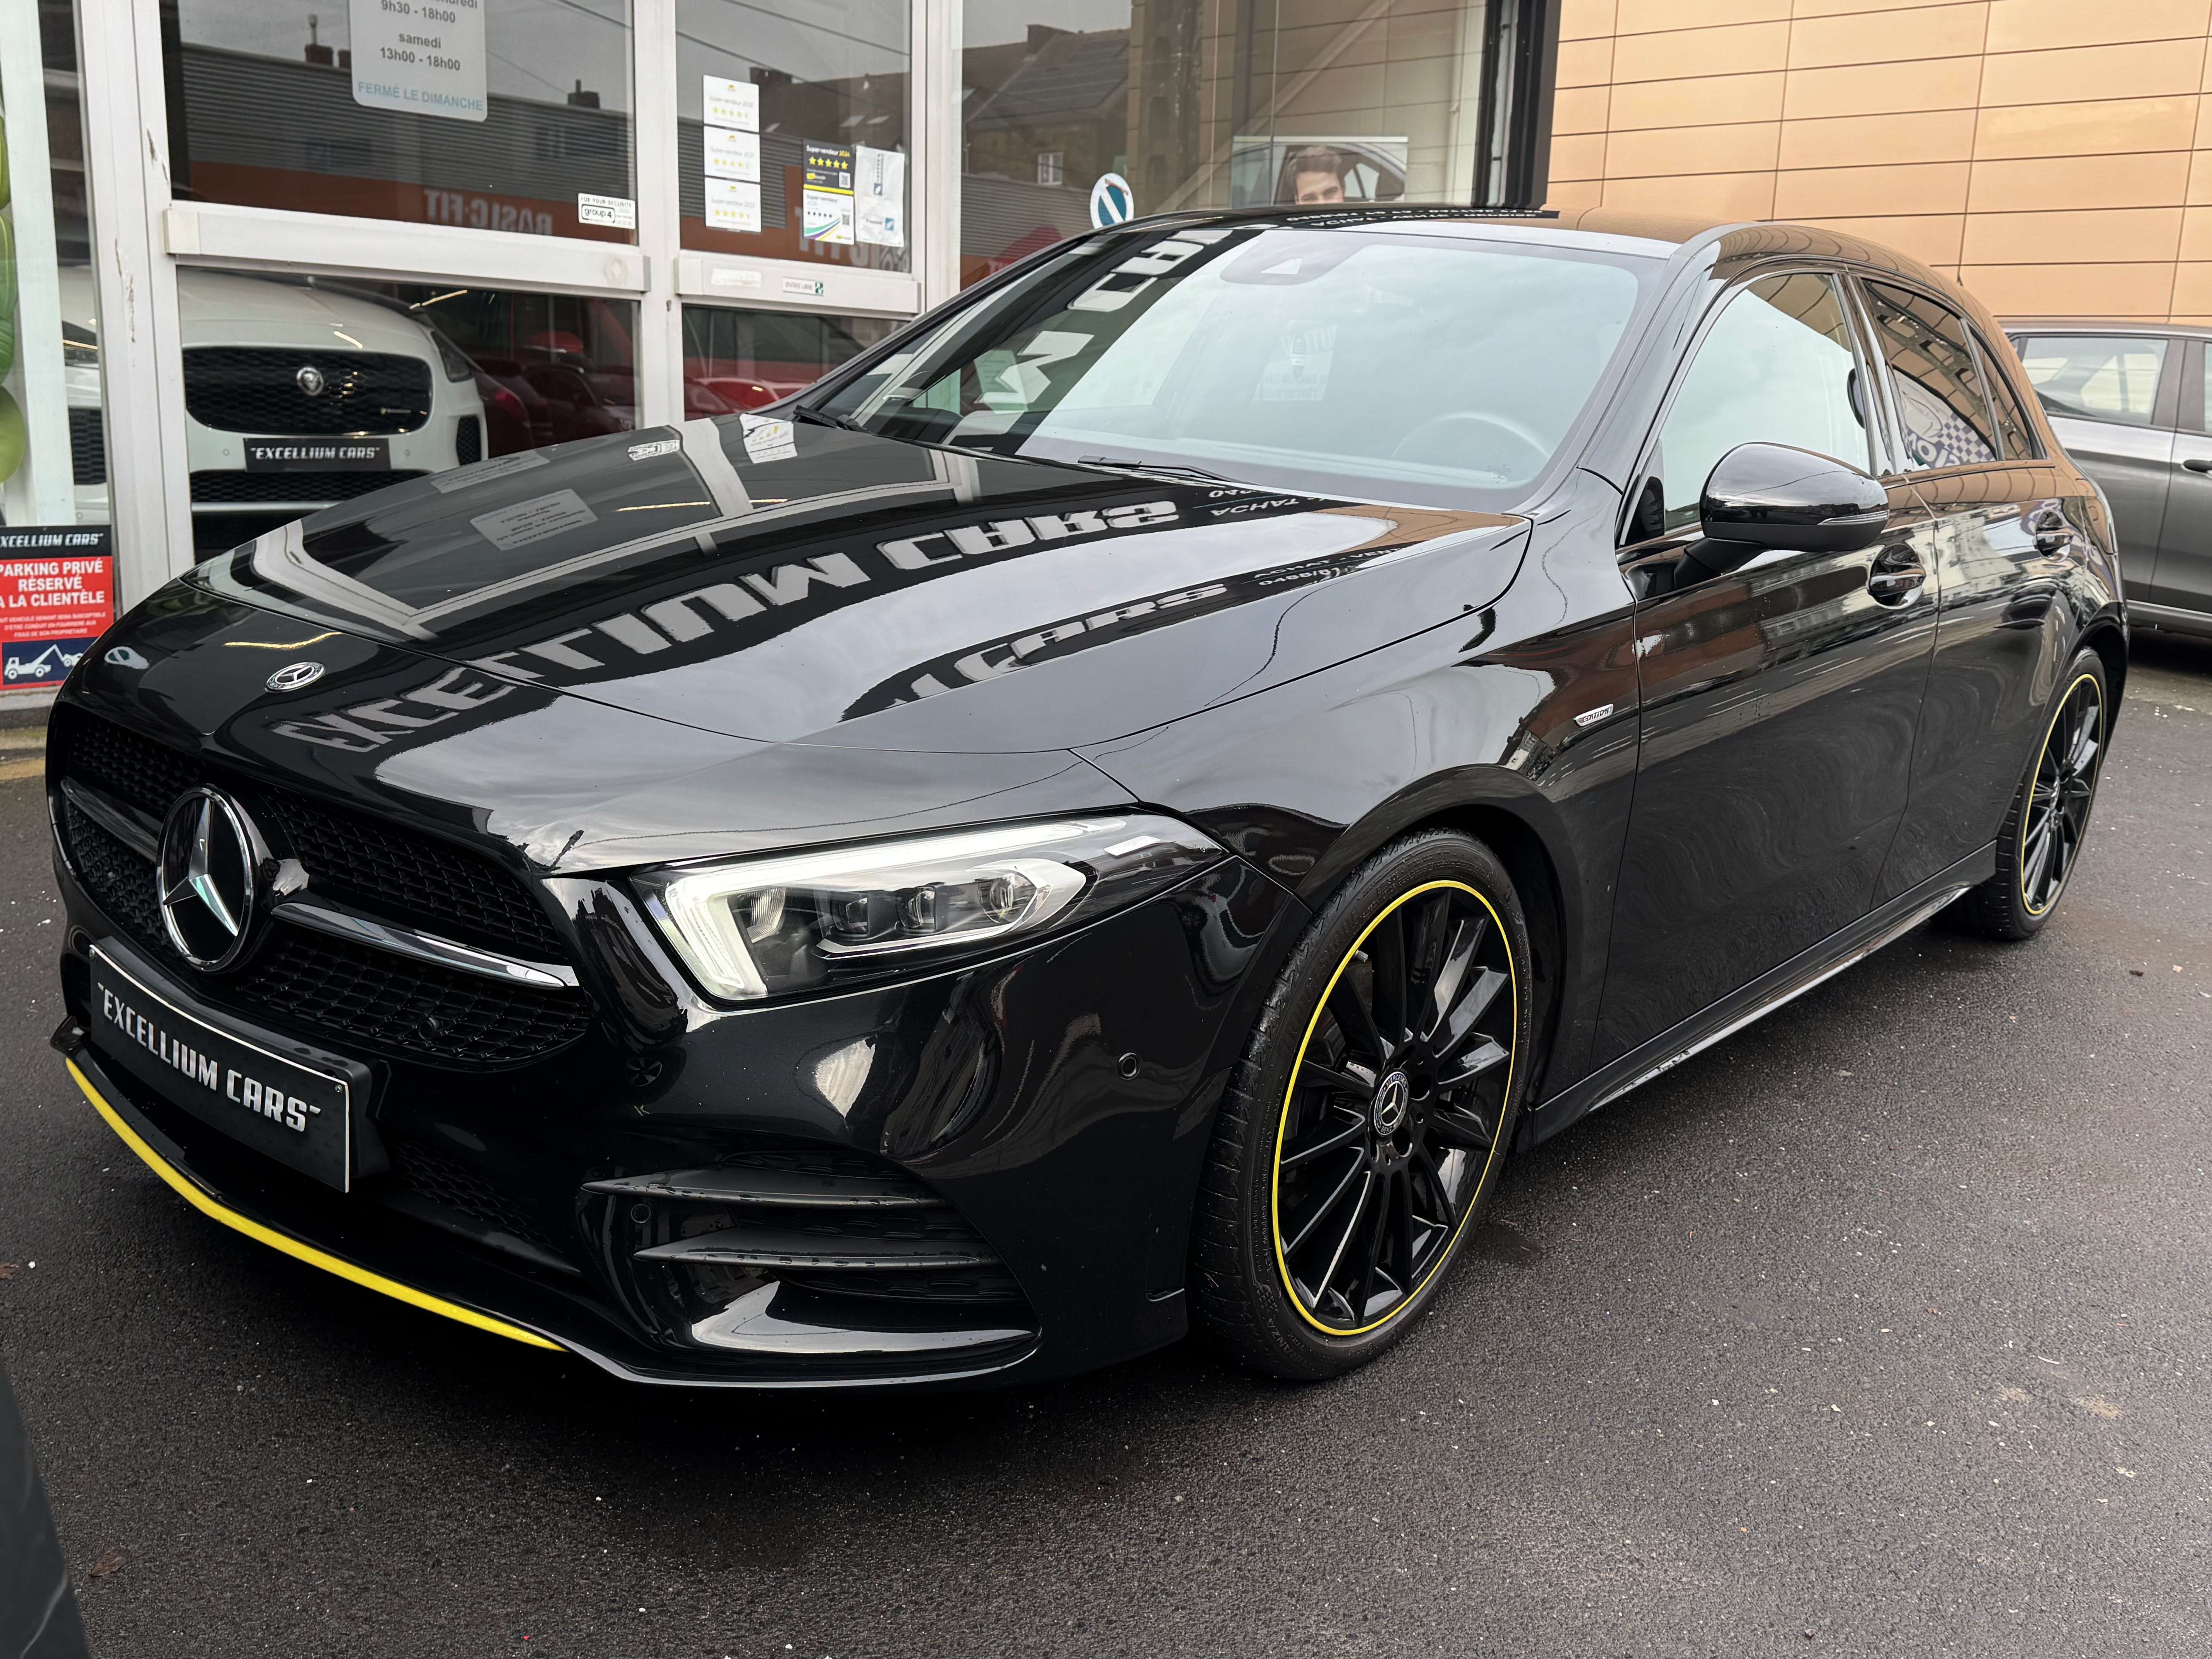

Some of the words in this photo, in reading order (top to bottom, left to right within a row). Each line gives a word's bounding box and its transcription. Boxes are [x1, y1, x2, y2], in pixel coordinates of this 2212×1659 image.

[381, 0, 410, 15] 9h30
[422, 7, 455, 23] 18h00
[398, 32, 441, 49] samedi
[380, 47, 415, 64] 13h00
[427, 55, 460, 70] 18h00
[358, 81, 400, 98] FERMÉ
[404, 88, 418, 101] LE
[422, 91, 483, 111] DIMANCHE
[255, 447, 336, 460] EXCELLIUM
[339, 447, 376, 459] CARS
[0, 533, 63, 548] XCELLIUM
[65, 533, 98, 546] CARS
[63, 557, 103, 575] PRIVÉ
[18, 574, 82, 592] RÉSERVÉ
[9, 594, 27, 608] LA
[31, 589, 105, 607] CLIENTÈLE
[103, 988, 218, 1092] EXCELLIUM
[226, 1068, 307, 1132] CARS
